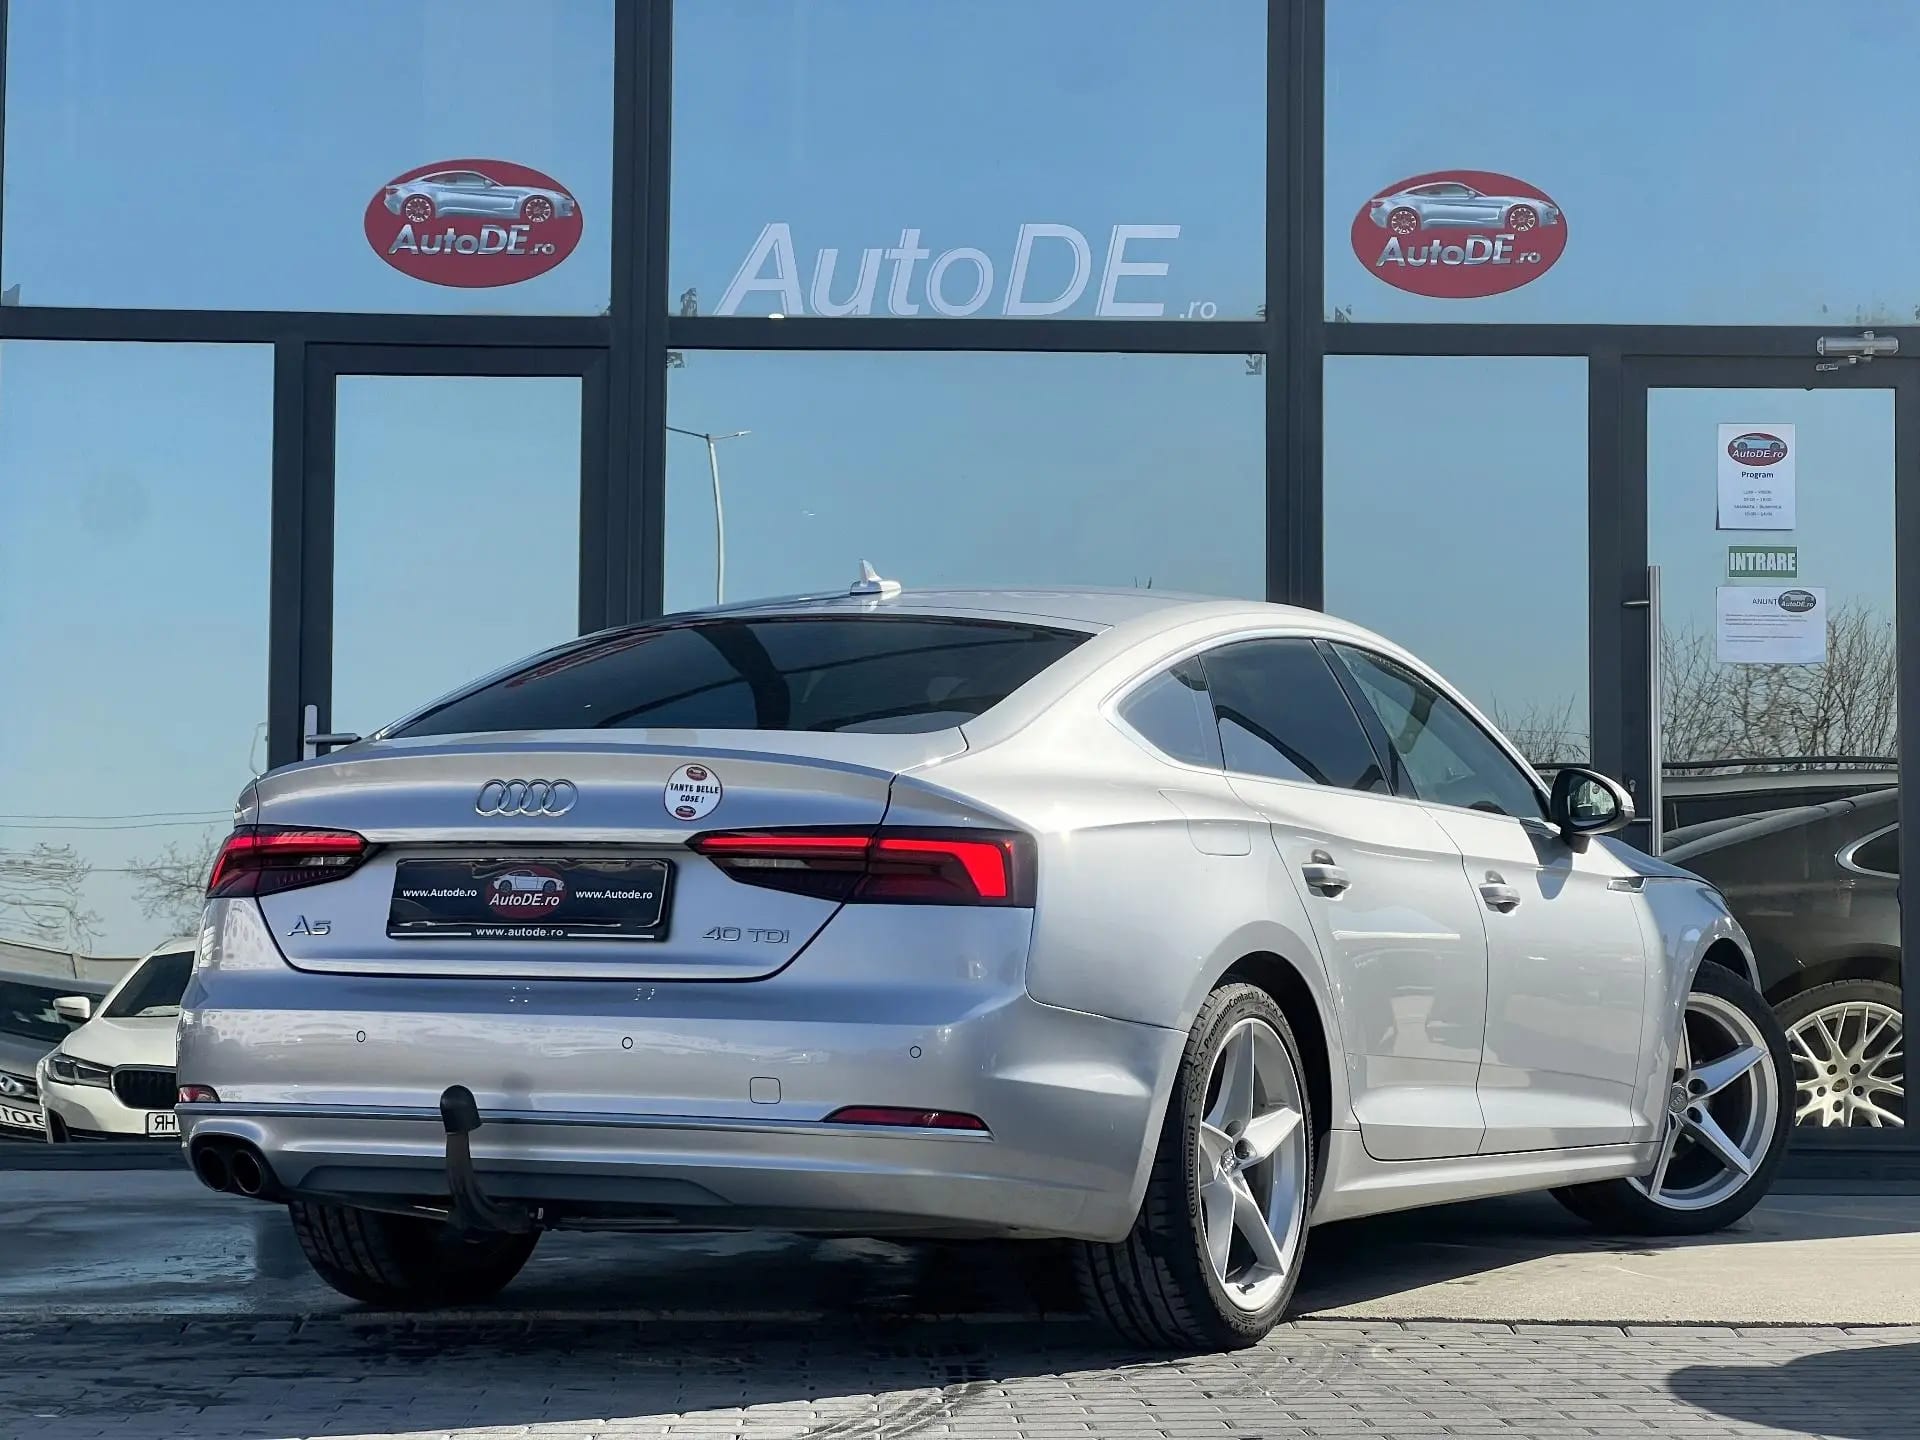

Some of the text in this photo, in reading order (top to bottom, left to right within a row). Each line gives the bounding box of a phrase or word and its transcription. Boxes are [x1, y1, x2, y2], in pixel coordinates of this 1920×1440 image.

[1731, 448, 1785, 459] AutoDE.ro
[1741, 471, 1774, 480] Program
[1729, 552, 1797, 572] INTRARE
[402, 887, 654, 907] www.Autode.ro AutoDE.ro www.Autode.ro
[287, 914, 332, 937] A5
[475, 926, 564, 938] www.autode.ro
[702, 926, 790, 944] 40 TDI
